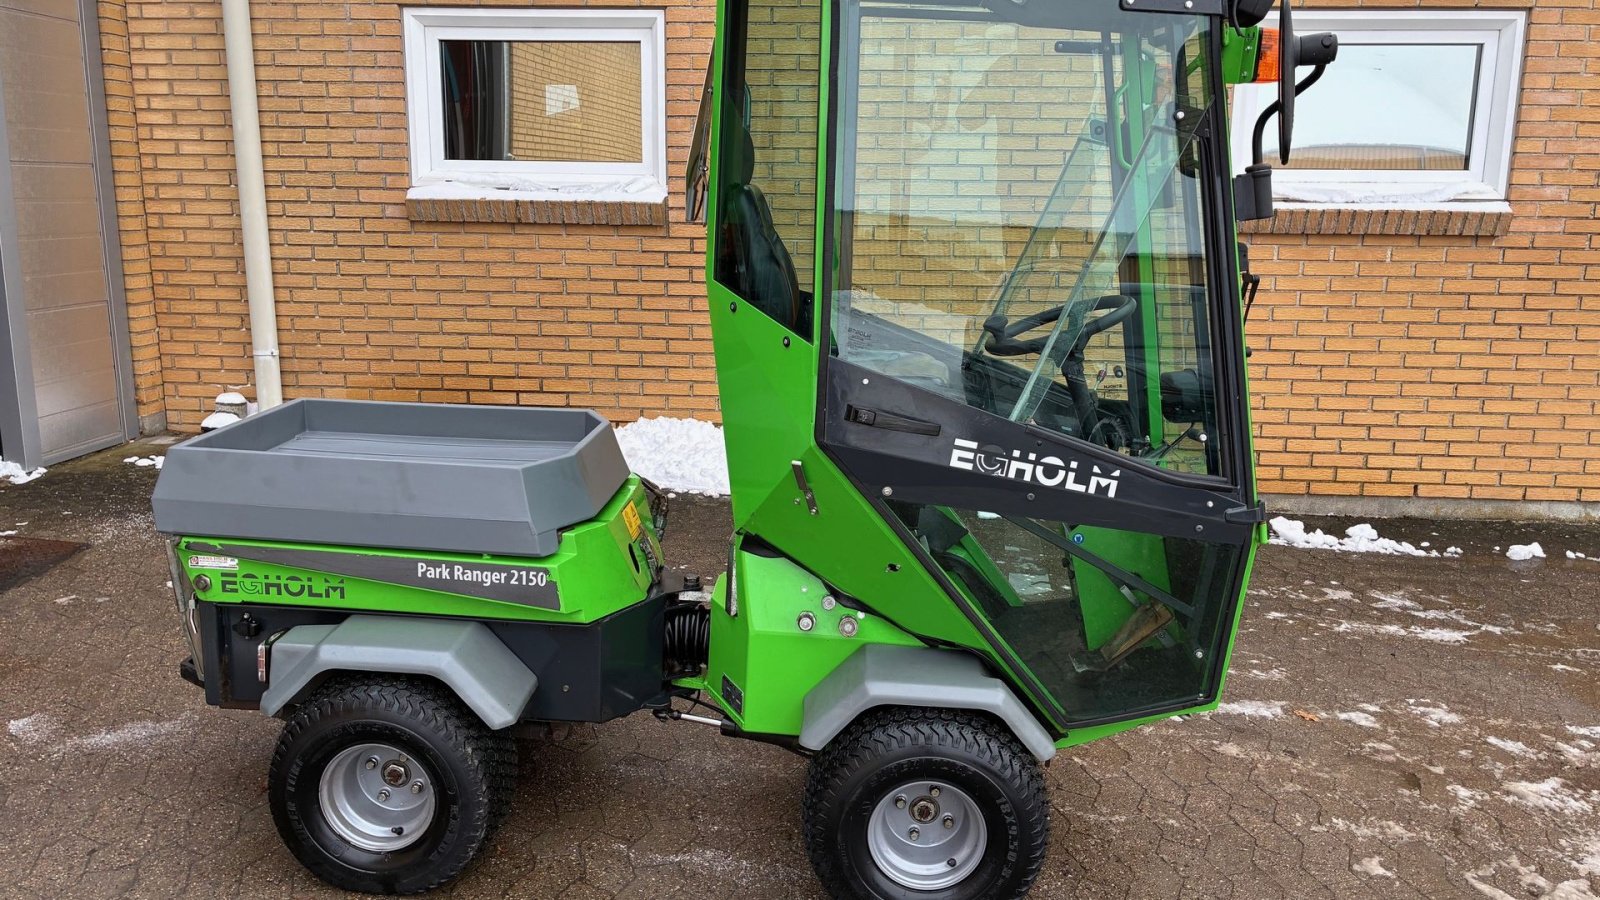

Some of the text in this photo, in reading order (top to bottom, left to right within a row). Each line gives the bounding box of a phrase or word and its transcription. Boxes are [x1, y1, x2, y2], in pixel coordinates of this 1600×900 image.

[949, 438, 1121, 498] EGHOLM
[220, 572, 346, 600] EGHOLM
[417, 562, 547, 587] Park Ranger 2150
